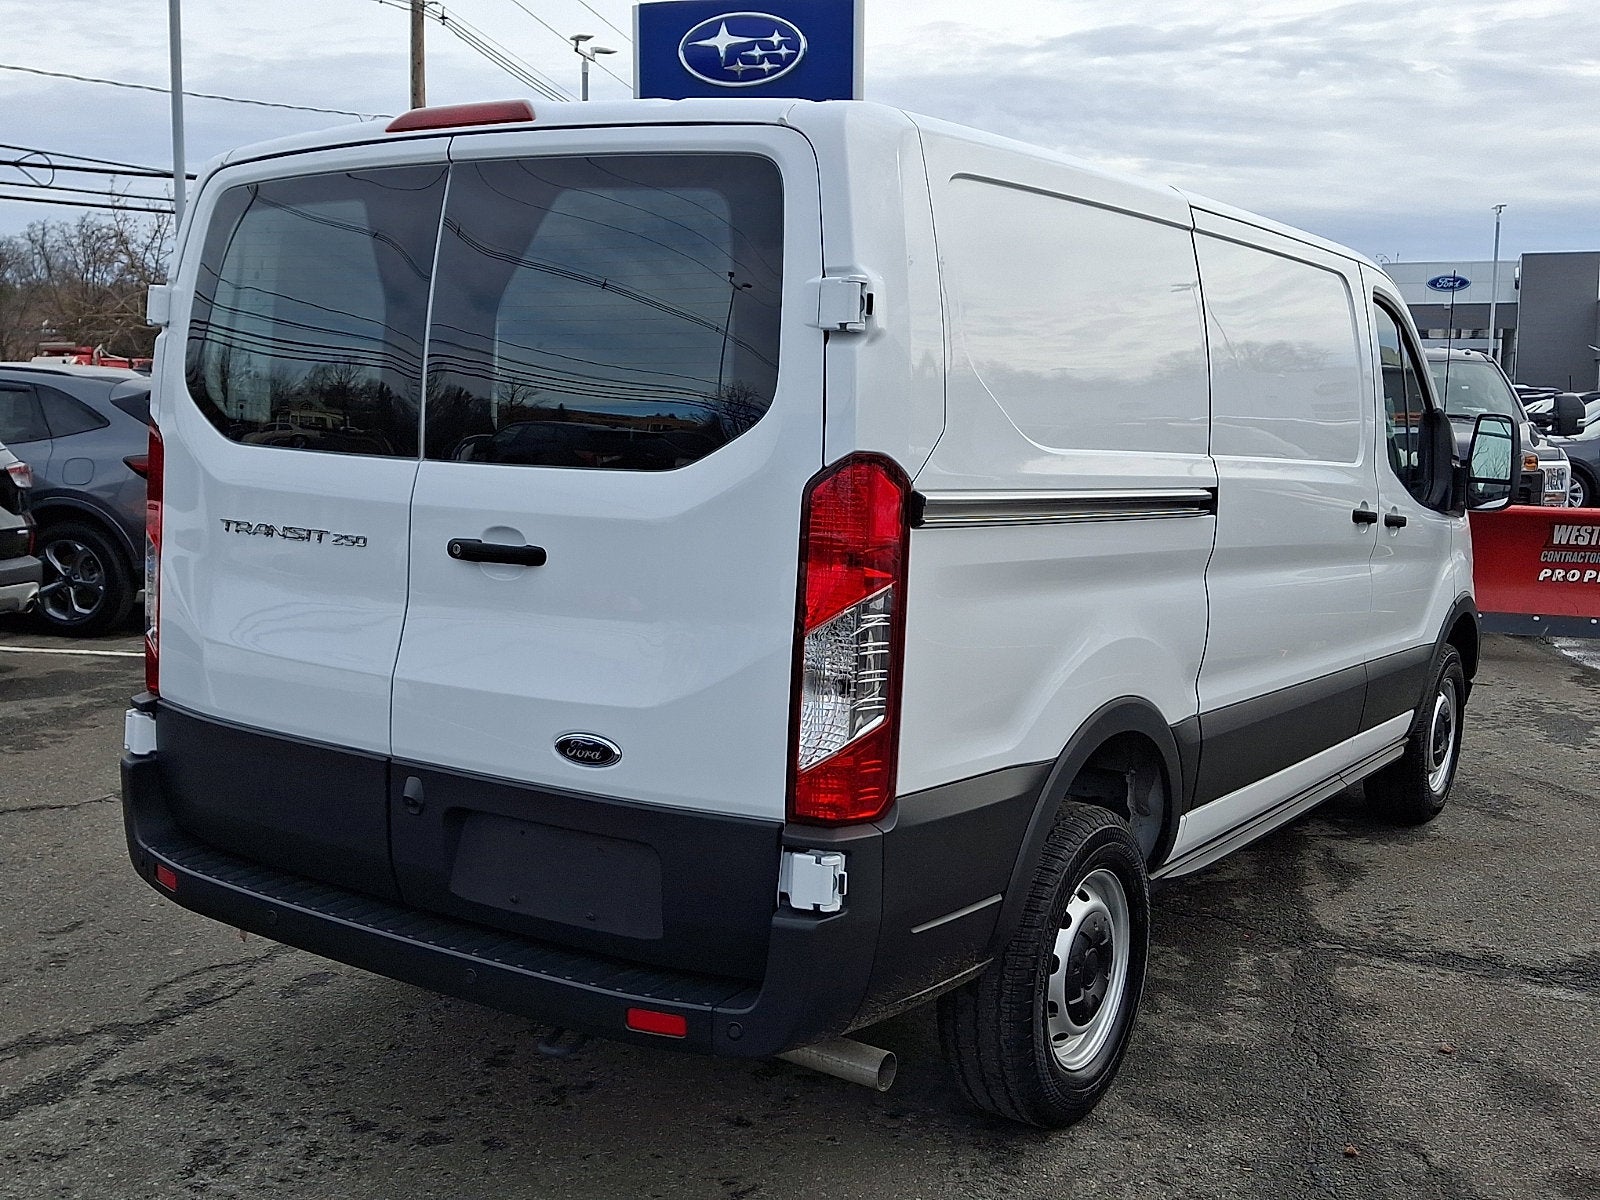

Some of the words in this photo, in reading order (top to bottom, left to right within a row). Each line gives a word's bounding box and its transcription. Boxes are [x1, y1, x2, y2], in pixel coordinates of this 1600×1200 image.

[220, 518, 330, 543] TRANSIT
[332, 533, 368, 547] 250
[1553, 524, 1600, 546] WEST
[566, 739, 602, 760] Ford
